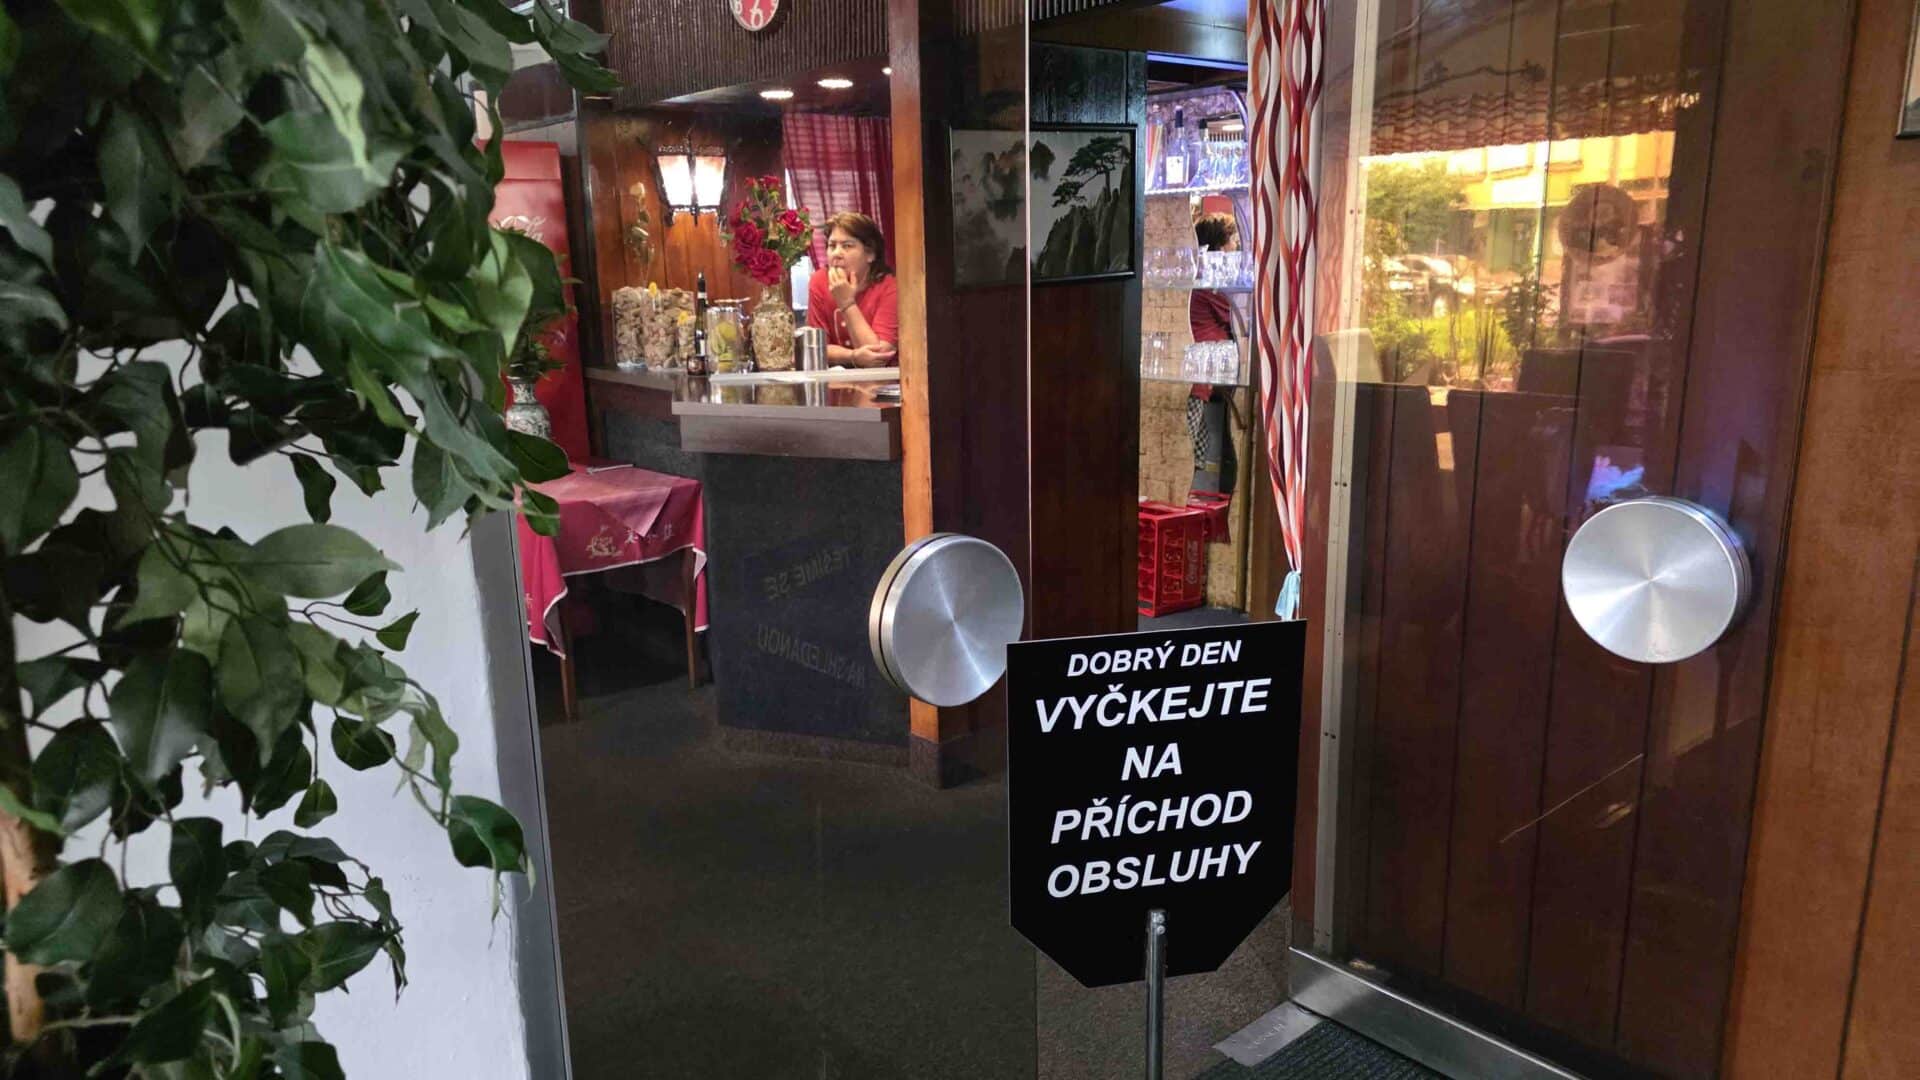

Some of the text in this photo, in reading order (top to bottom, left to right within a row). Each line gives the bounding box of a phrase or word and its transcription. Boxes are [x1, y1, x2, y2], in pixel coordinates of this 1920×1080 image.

[1067, 639, 1241, 677] DOBRÝ DEN
[1035, 678, 1271, 733] VYČKEJTE
[1121, 742, 1182, 781] NA
[1050, 790, 1253, 844] PŘÍCHOD
[1047, 840, 1262, 898] OBSLUHY
